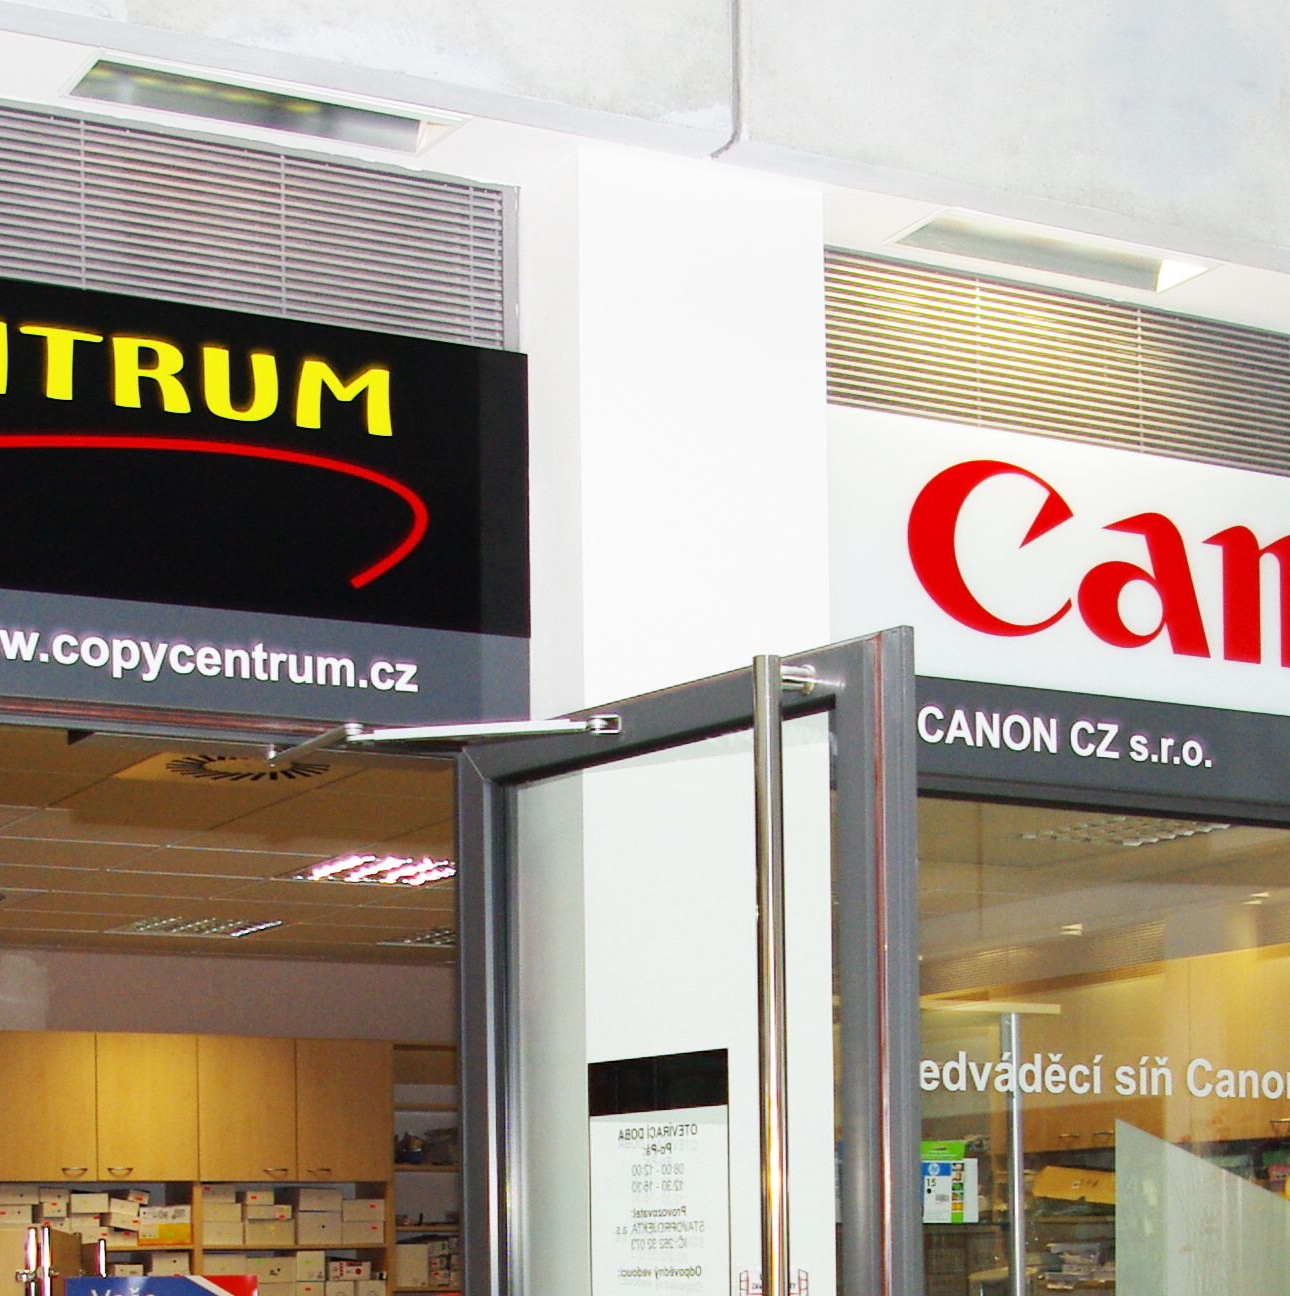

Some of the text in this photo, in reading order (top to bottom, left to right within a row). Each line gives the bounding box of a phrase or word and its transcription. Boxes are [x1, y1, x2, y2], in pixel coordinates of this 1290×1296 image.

[917, 704, 1213, 768] CANON CZ s.r.o.
[920, 1051, 1102, 1095] edváděcí
[1115, 1055, 1173, 1096] síň
[926, 1178, 937, 1188] 15
